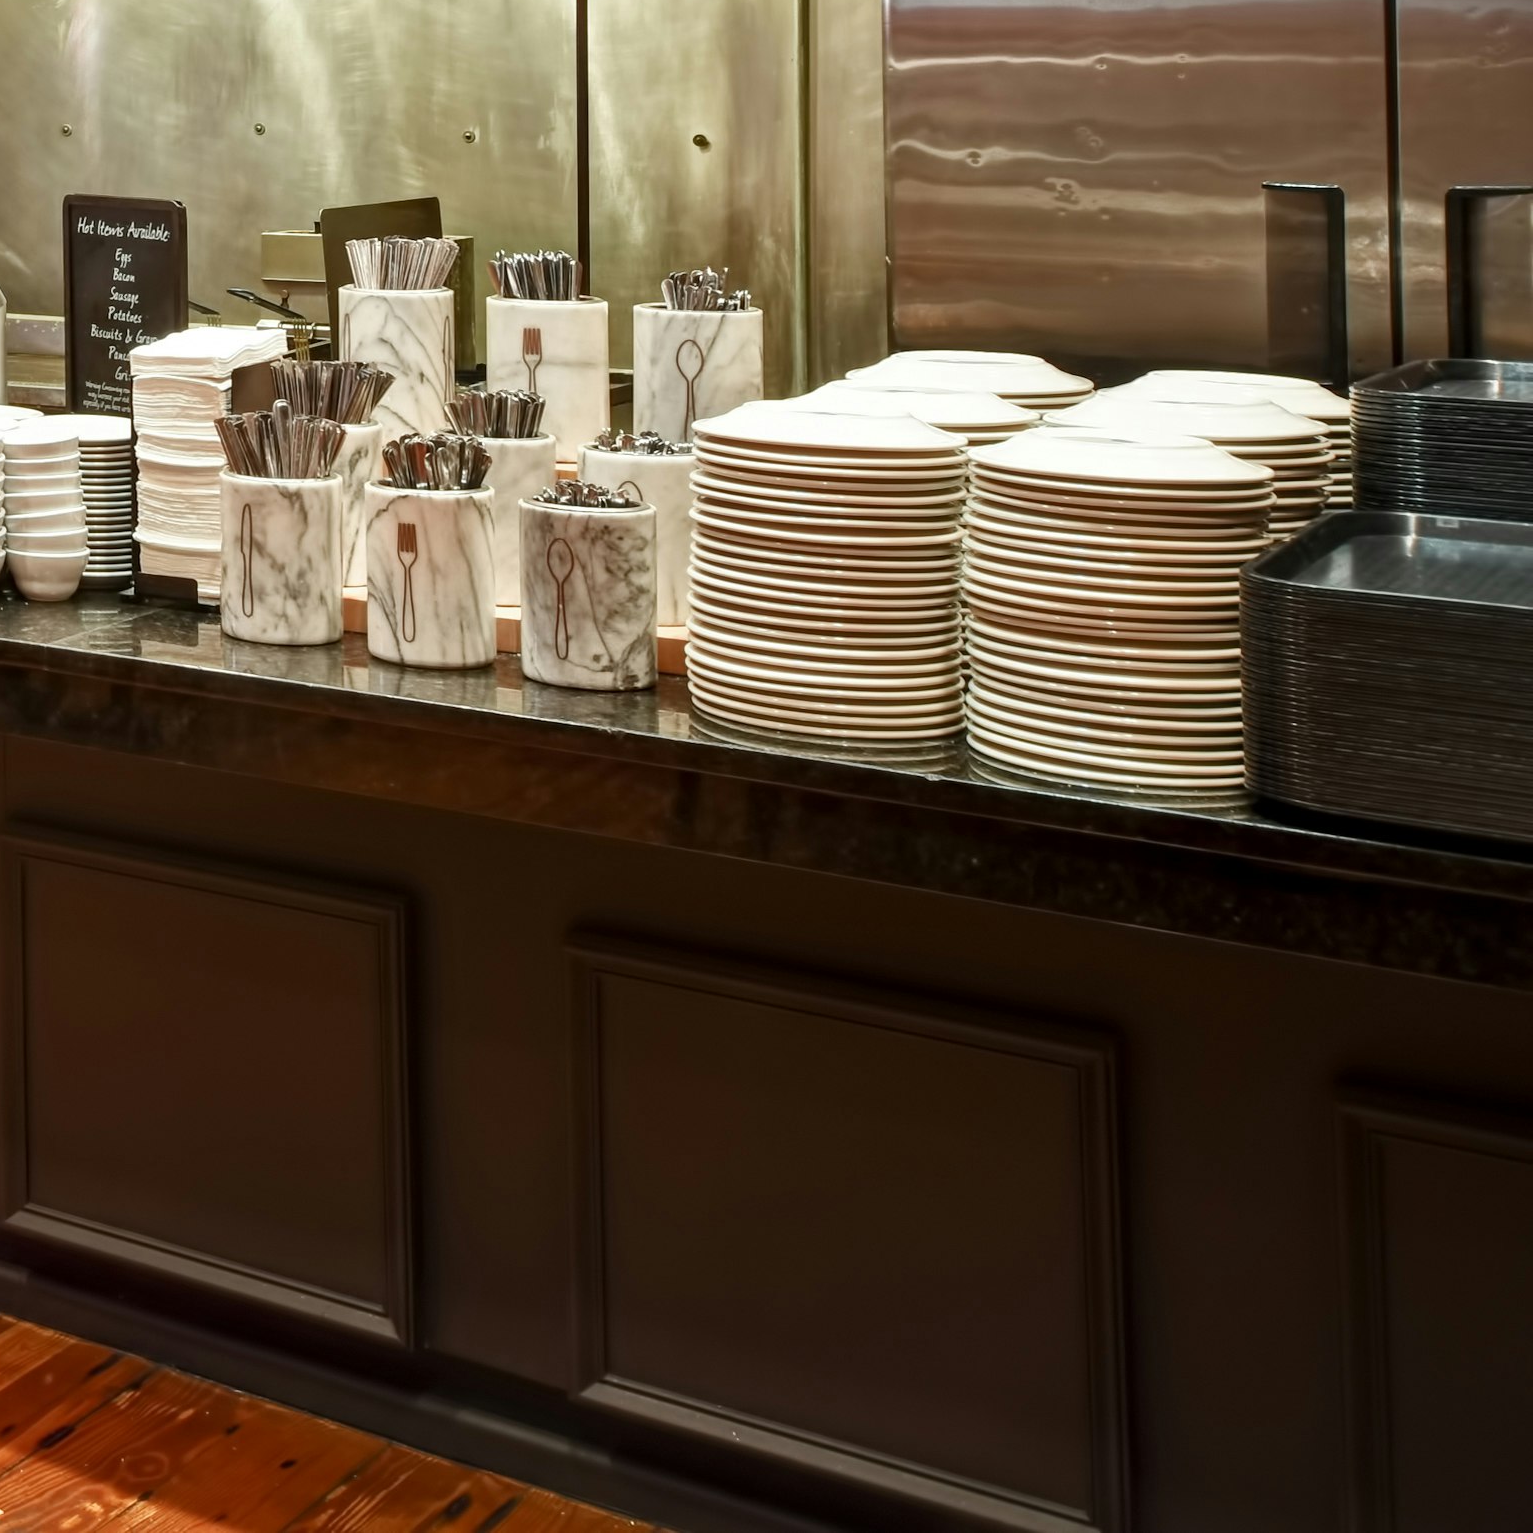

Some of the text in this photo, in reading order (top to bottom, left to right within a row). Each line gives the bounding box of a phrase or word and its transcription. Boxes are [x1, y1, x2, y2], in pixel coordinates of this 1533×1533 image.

[77, 216, 95, 234] Hot
[97, 220, 124, 237] Items
[115, 248, 132, 268] Eggs
[113, 267, 135, 282] Bacon
[109, 286, 139, 309] Sausage
[108, 306, 142, 324] Potatoes
[90, 324, 123, 341] Biscuits
[125, 328, 133, 343] &
